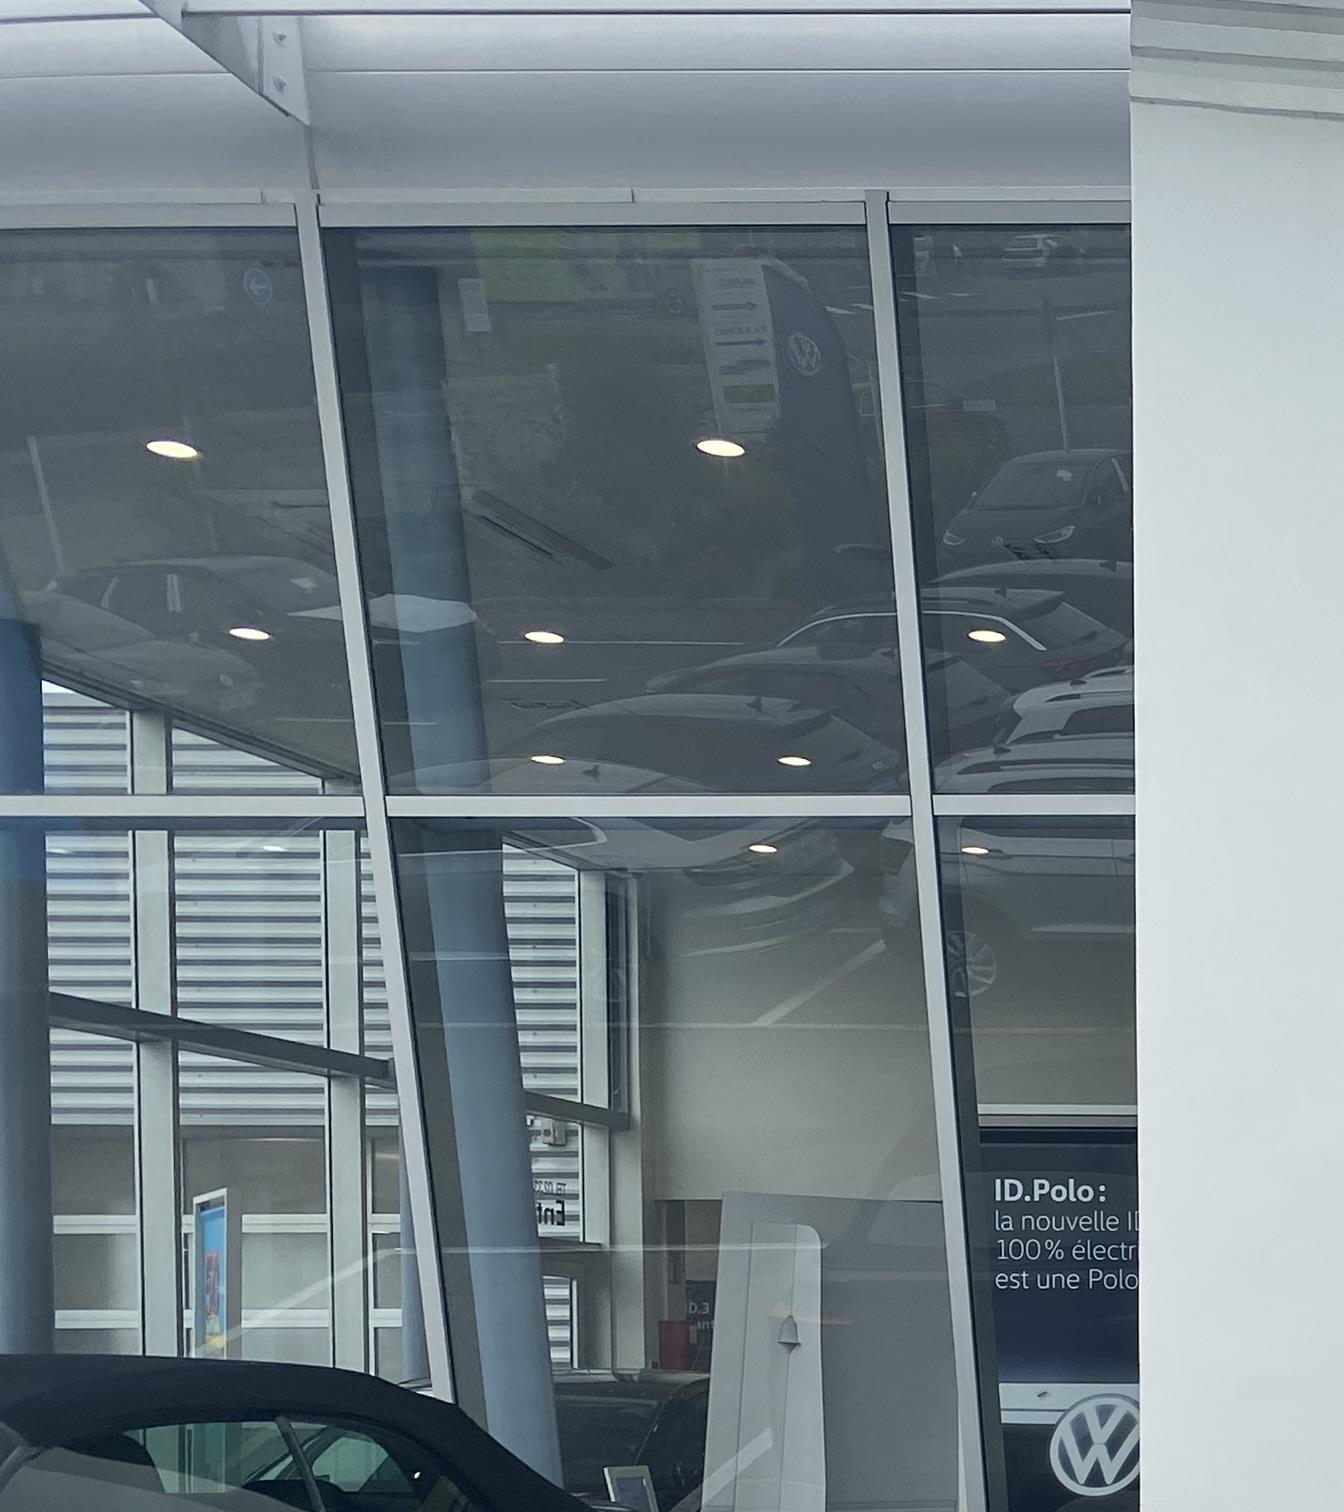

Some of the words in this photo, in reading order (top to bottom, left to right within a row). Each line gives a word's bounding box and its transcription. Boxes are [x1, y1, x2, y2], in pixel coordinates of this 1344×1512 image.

[994, 1209, 1014, 1231] la
[1021, 1209, 1120, 1231] nouvelle
[995, 1270, 1030, 1290] est
[1037, 1273, 1080, 1290] une
[1089, 1268, 1139, 1290] Polo
